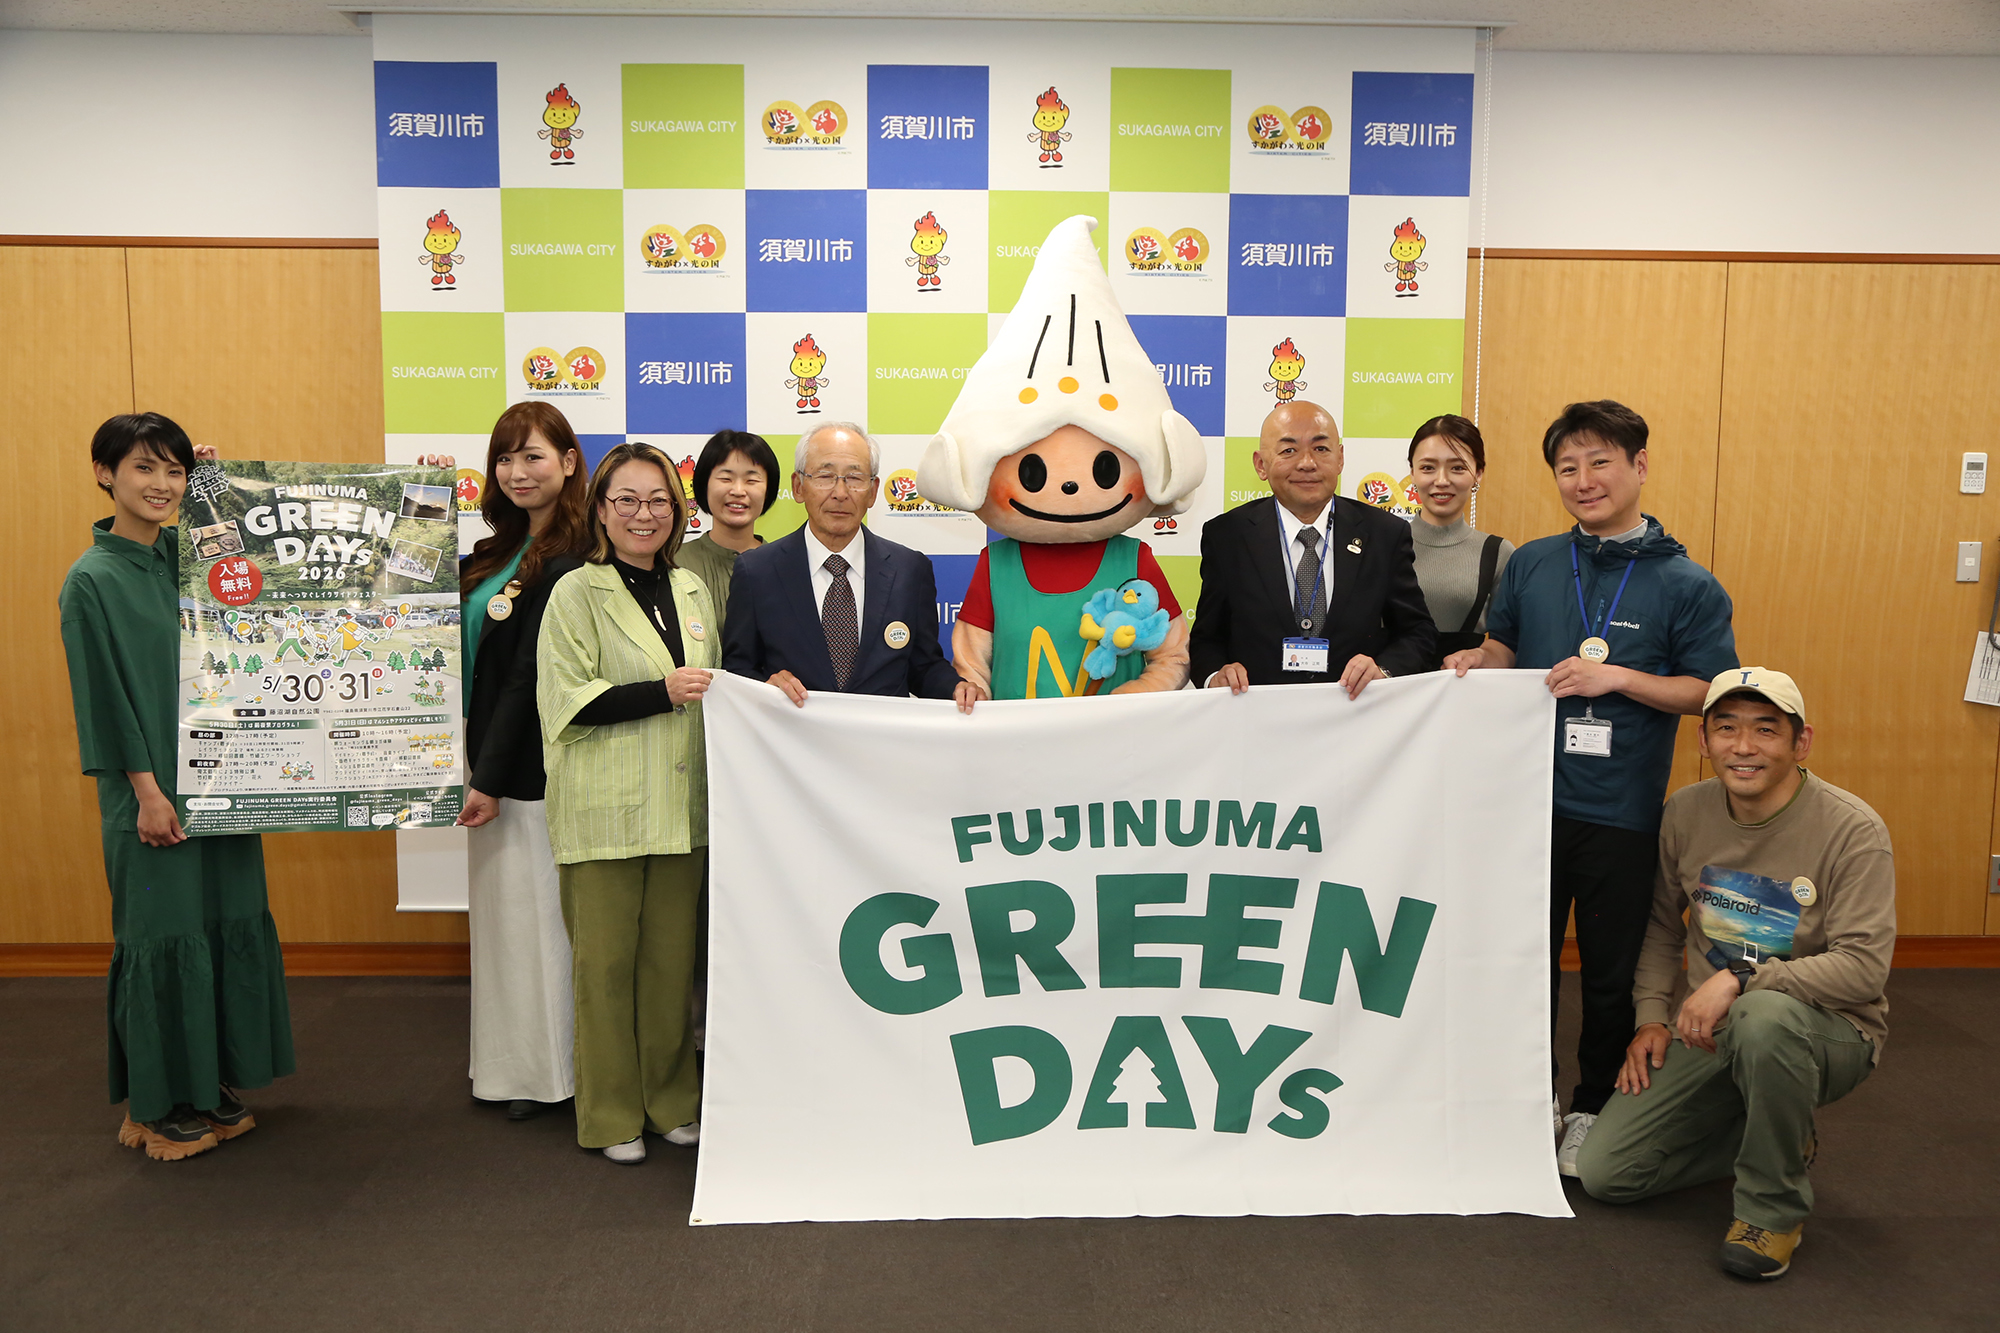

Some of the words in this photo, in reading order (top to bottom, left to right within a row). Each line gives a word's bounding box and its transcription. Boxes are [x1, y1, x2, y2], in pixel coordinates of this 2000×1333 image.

[388, 112, 485, 138] 須賀川市
[630, 120, 704, 133] SUKAGAWA
[708, 120, 737, 133] CITY
[880, 115, 976, 141] 須賀川市
[1118, 124, 1191, 137] SUKAGAWA
[1195, 124, 1224, 137] CITY
[765, 136, 841, 145] すかがわ×光の国
[1363, 121, 1458, 148] 須賀川市
[1251, 141, 1325, 150] すかがわ×光の国
[510, 243, 583, 256] SUKAGAWA
[587, 243, 617, 256] CITY
[759, 237, 854, 263] 須賀川市
[1241, 242, 1335, 268] 須賀川市
[645, 259, 720, 268] すかがわ×光の国
[1129, 262, 1203, 272] すかがわ×光の国
[392, 366, 466, 379] SUKAGAWA
[469, 366, 498, 379] CITY
[638, 360, 734, 385] 須賀川市
[875, 367, 948, 380] SUKAGAWA
[1352, 371, 1423, 384] SUKAGAWA
[1427, 371, 1455, 384] CITY
[527, 381, 600, 391] すかがわ×光の国
[274, 485, 368, 500] FUJINUMA
[888, 503, 963, 512] すかがわ×光の
[244, 501, 396, 539] GREEN
[273, 534, 374, 566] DAYs
[219, 561, 249, 577] 入場
[298, 566, 346, 580] 2026
[220, 576, 252, 593] 無料
[951, 799, 1323, 863] FUJINUMA
[1702, 891, 1761, 916] Polaroid
[839, 873, 1438, 1019] GREEN
[949, 1015, 1344, 1146] DAYs
